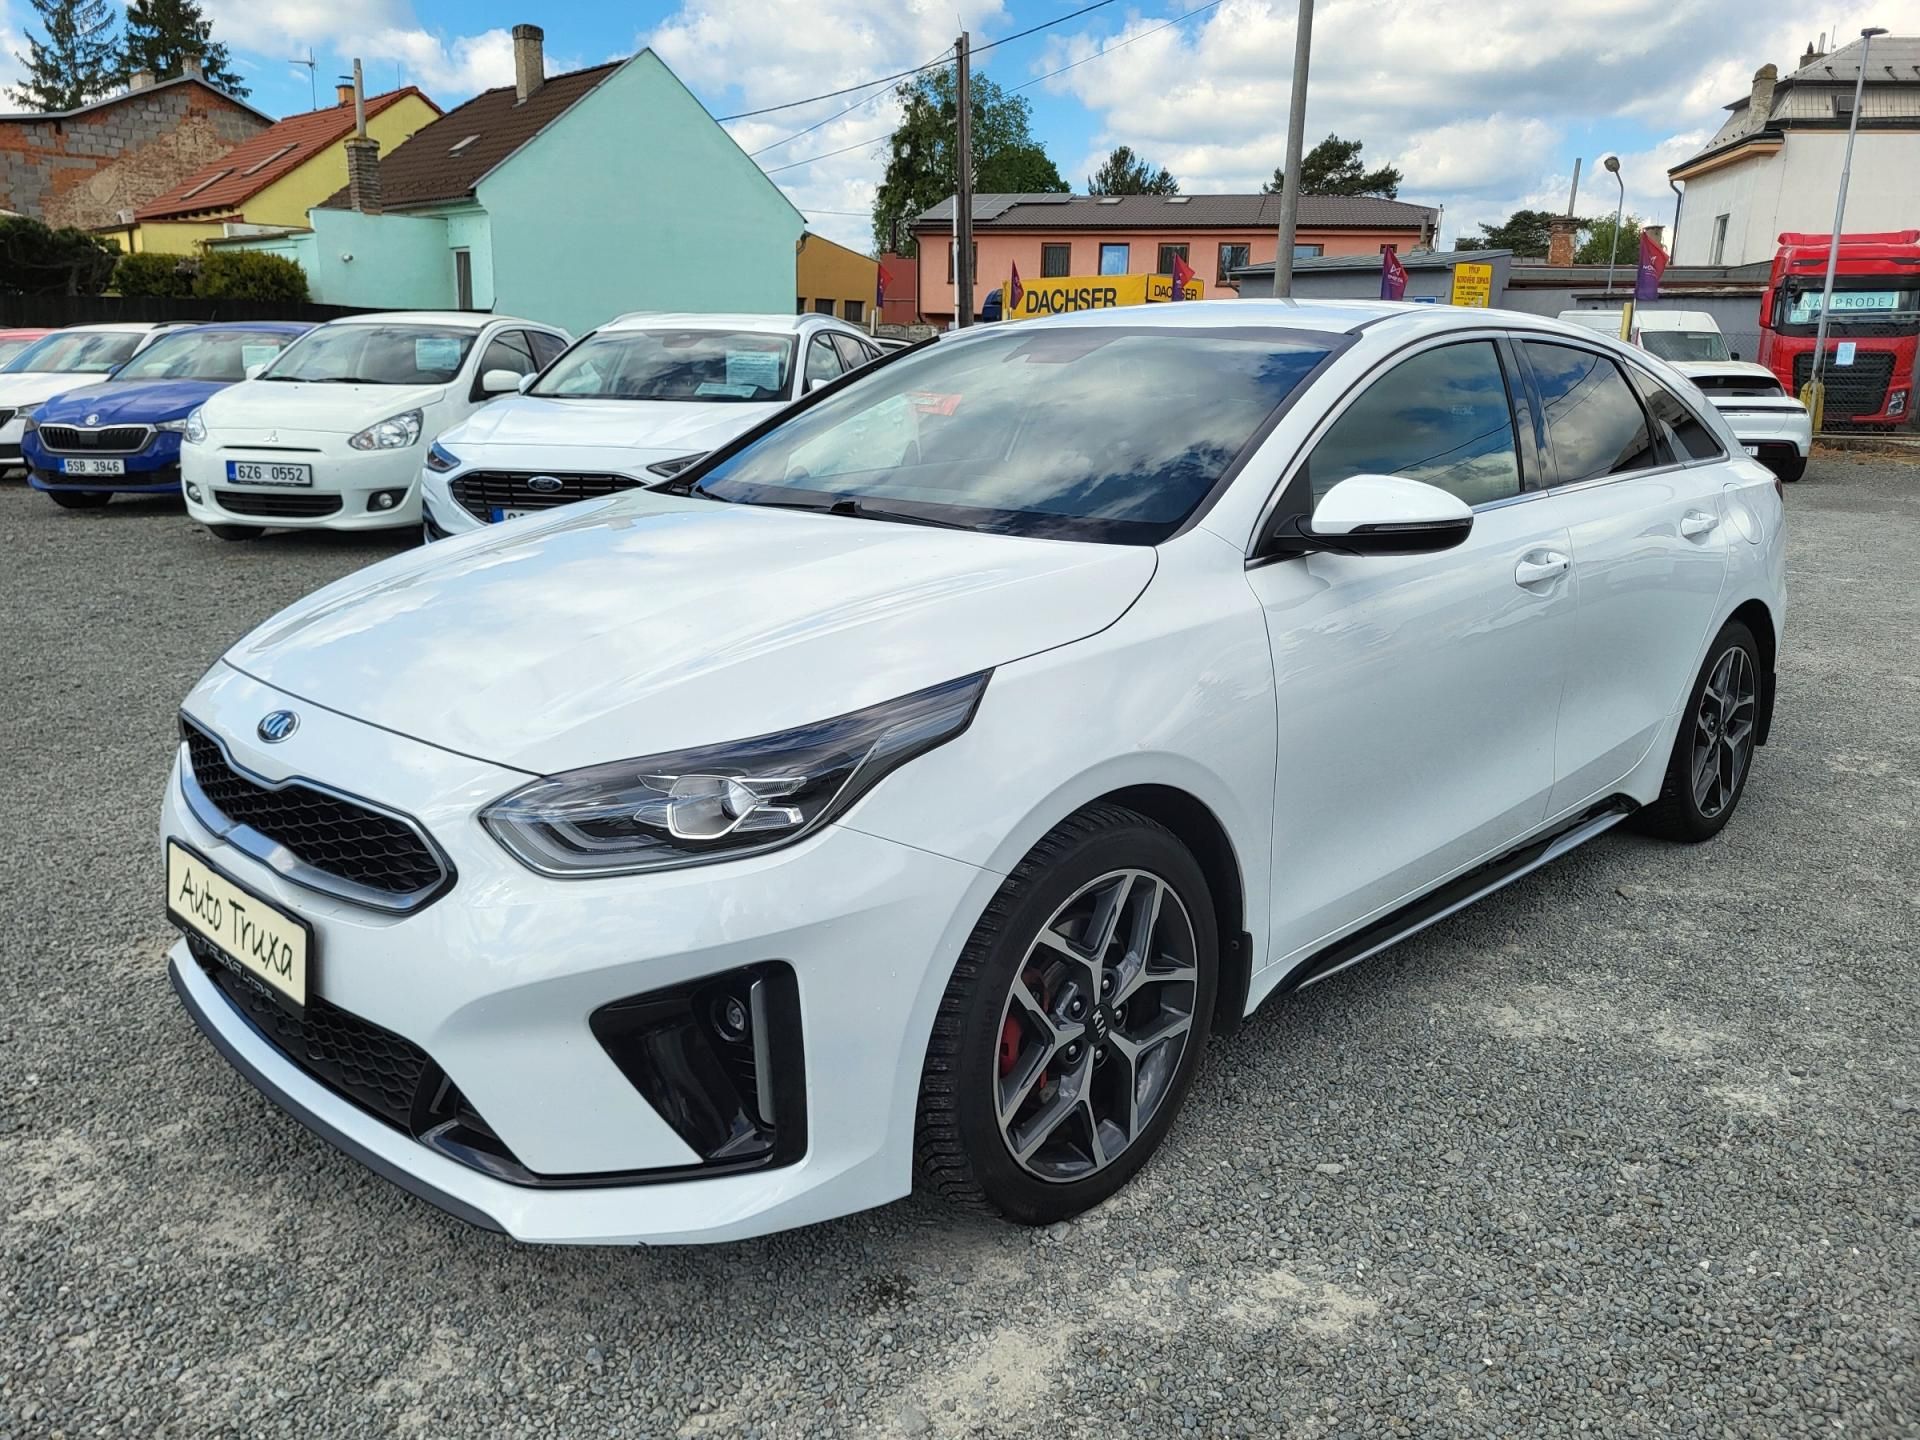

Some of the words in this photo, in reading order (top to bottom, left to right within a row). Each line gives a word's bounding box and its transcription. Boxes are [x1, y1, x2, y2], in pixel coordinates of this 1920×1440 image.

[1026, 288, 1117, 314] DACHSER
[1154, 285, 1198, 301] DACSER
[1803, 299, 1821, 309] NA
[1835, 298, 1894, 308] PRODEJ
[66, 460, 86, 472] 5SB
[92, 460, 120, 473] 3946
[238, 464, 262, 480] 6Z6
[271, 466, 304, 482] 0552
[179, 867, 222, 932] Auto
[228, 898, 293, 982] Truxa
[1092, 1009, 1107, 1039] KIA
